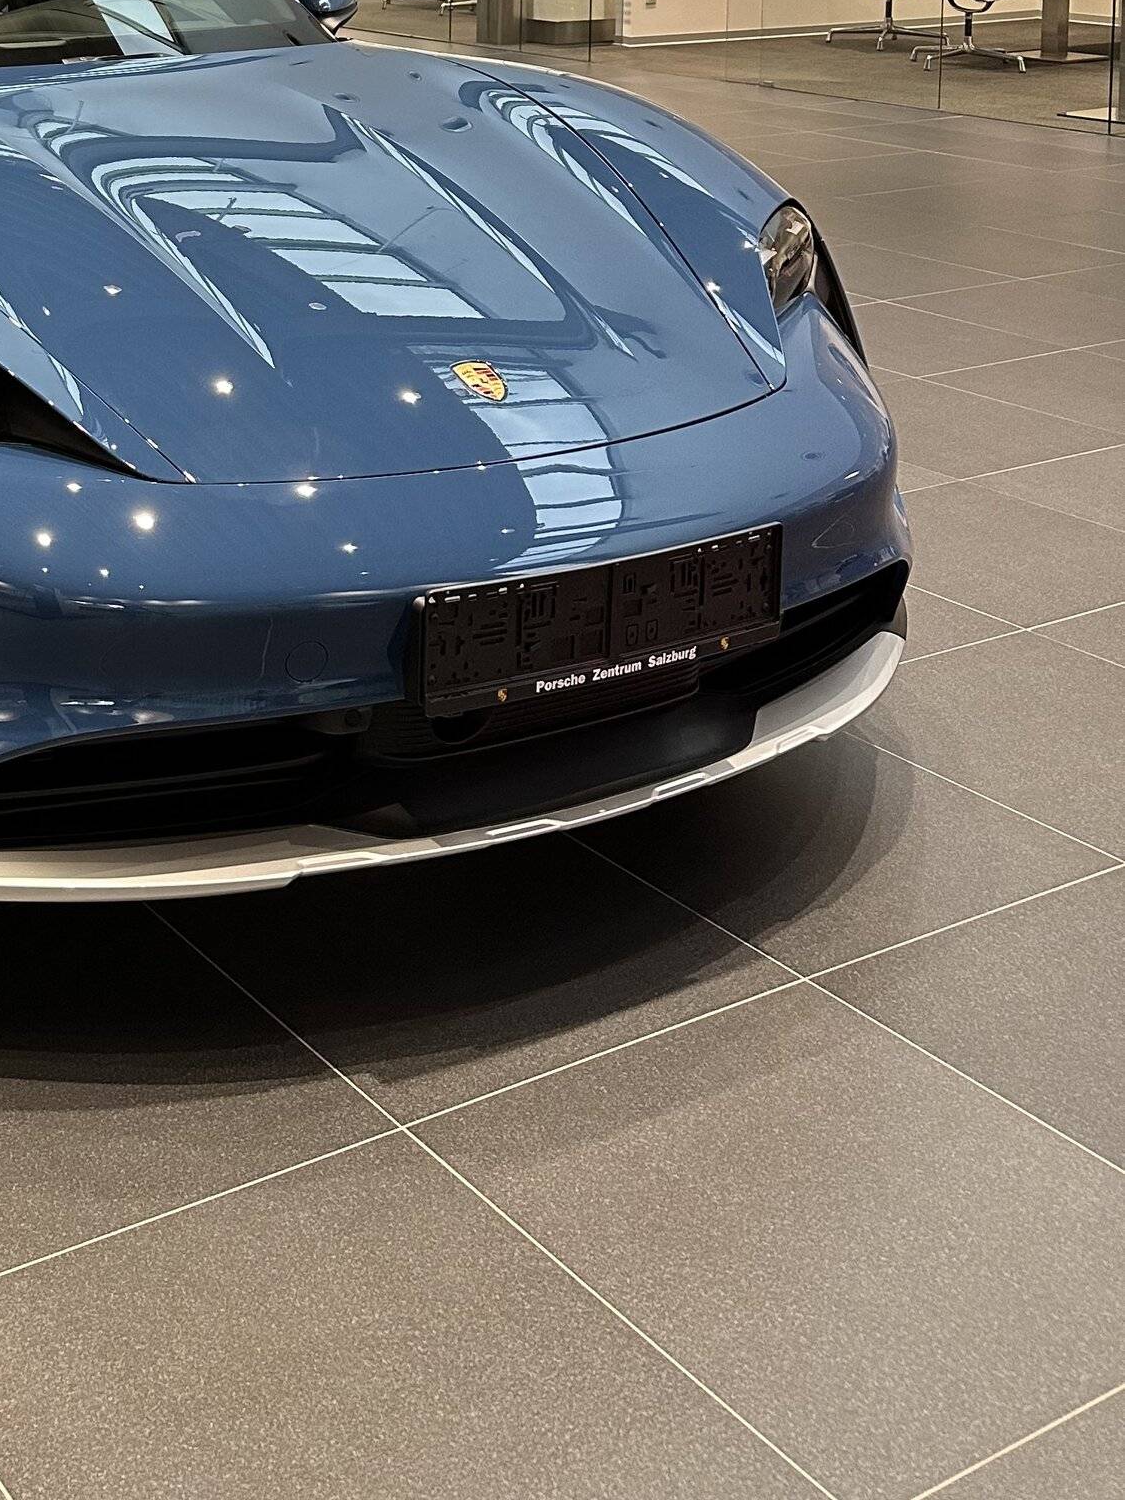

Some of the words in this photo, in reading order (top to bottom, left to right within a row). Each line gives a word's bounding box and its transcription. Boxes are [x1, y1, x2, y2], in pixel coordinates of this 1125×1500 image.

[536, 673, 586, 693] Porsche
[592, 661, 642, 681] Zentrum
[648, 645, 697, 668] Salzburg
